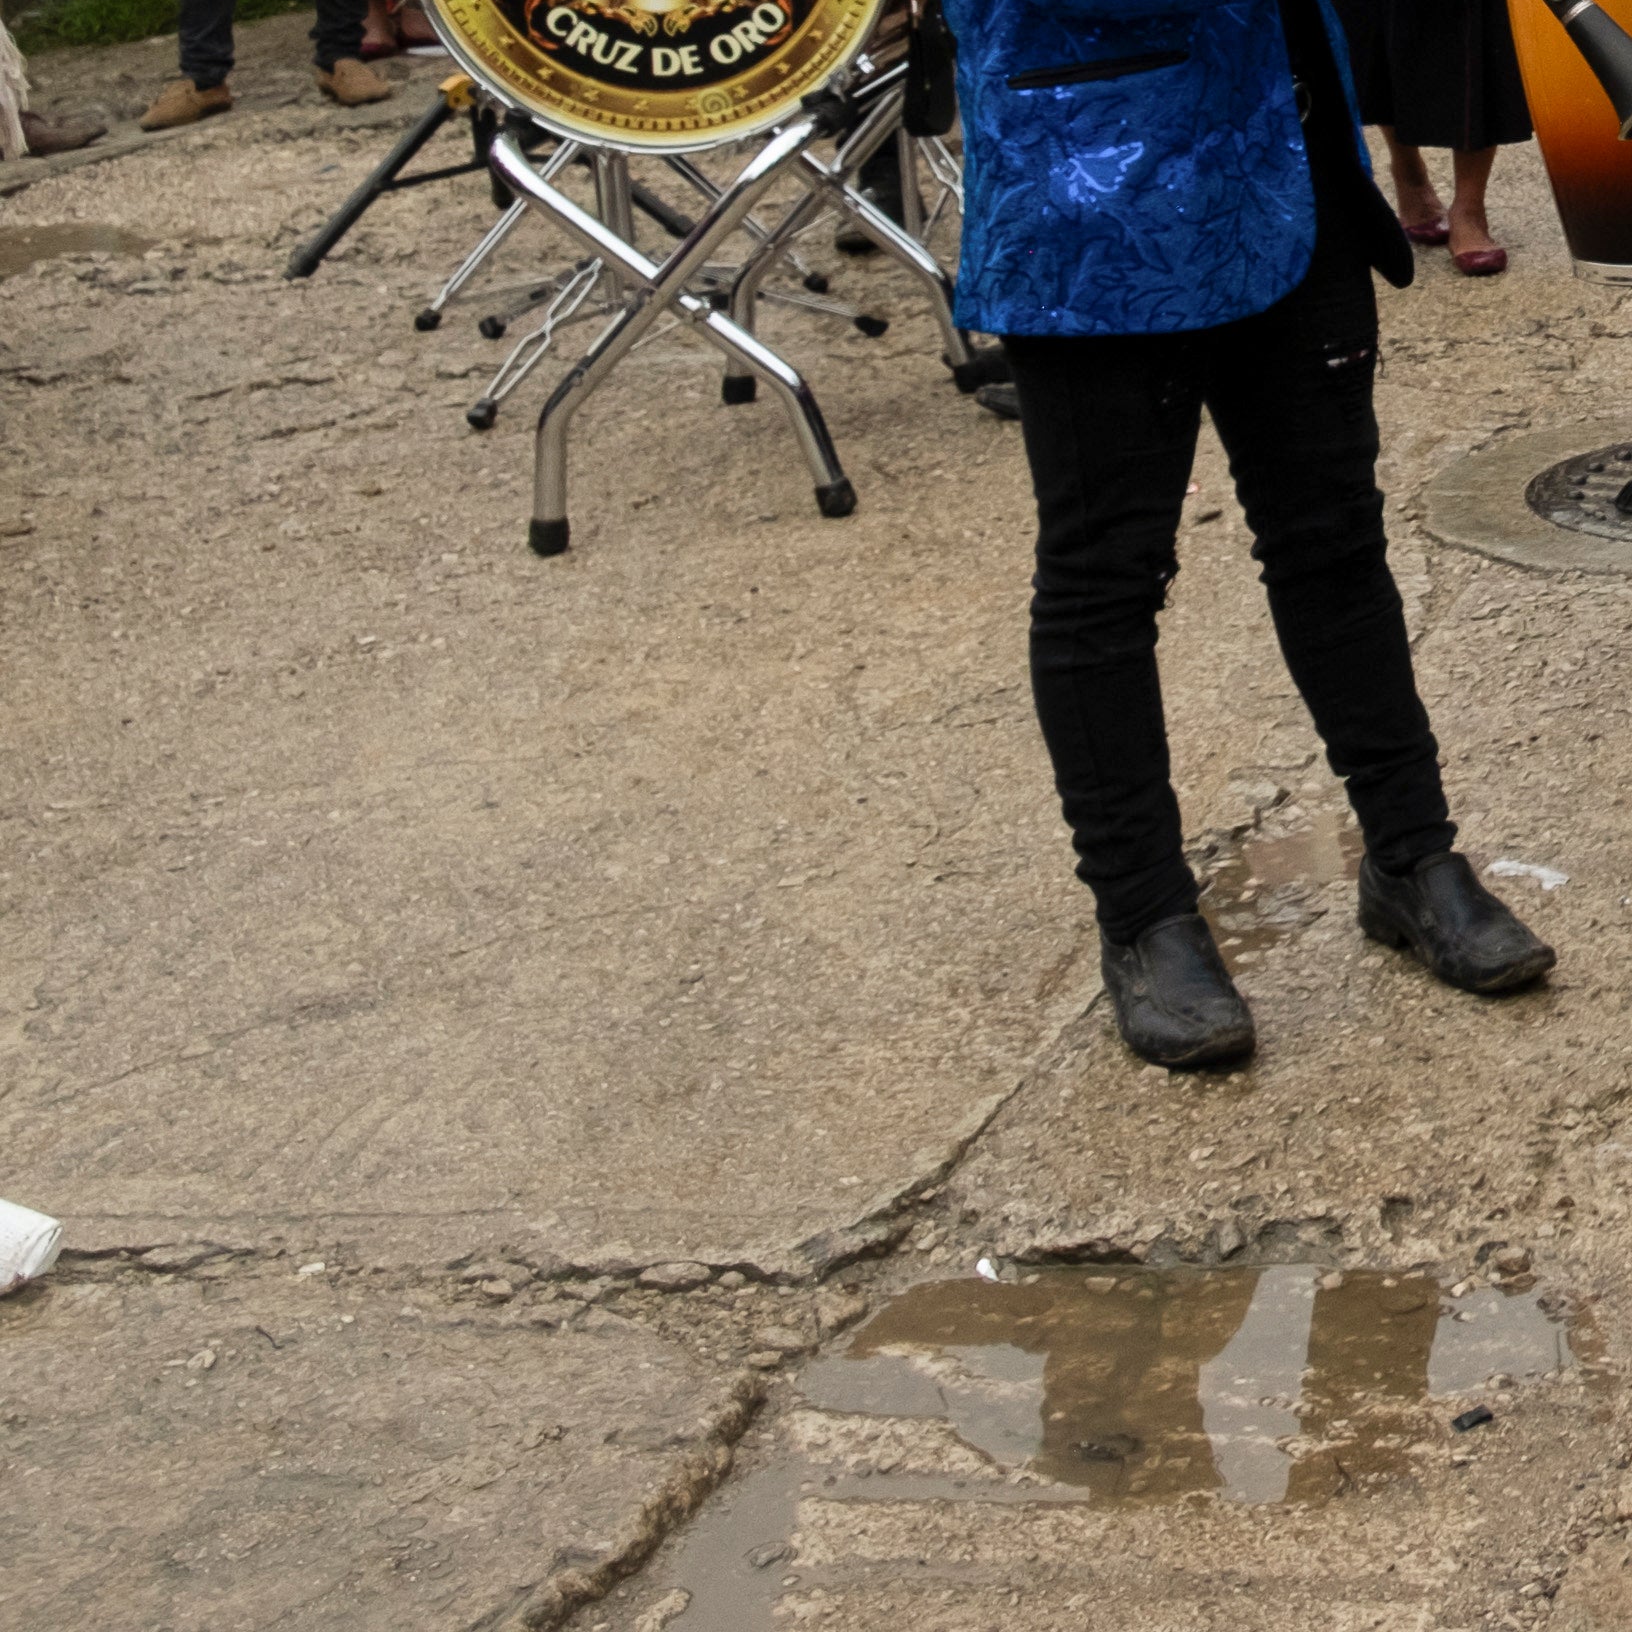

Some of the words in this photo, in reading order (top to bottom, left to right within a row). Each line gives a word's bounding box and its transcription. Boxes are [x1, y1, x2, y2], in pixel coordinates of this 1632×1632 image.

[545, 6, 644, 74] CRUZ
[650, 44, 704, 77] DE
[709, 2, 786, 65] ORO
